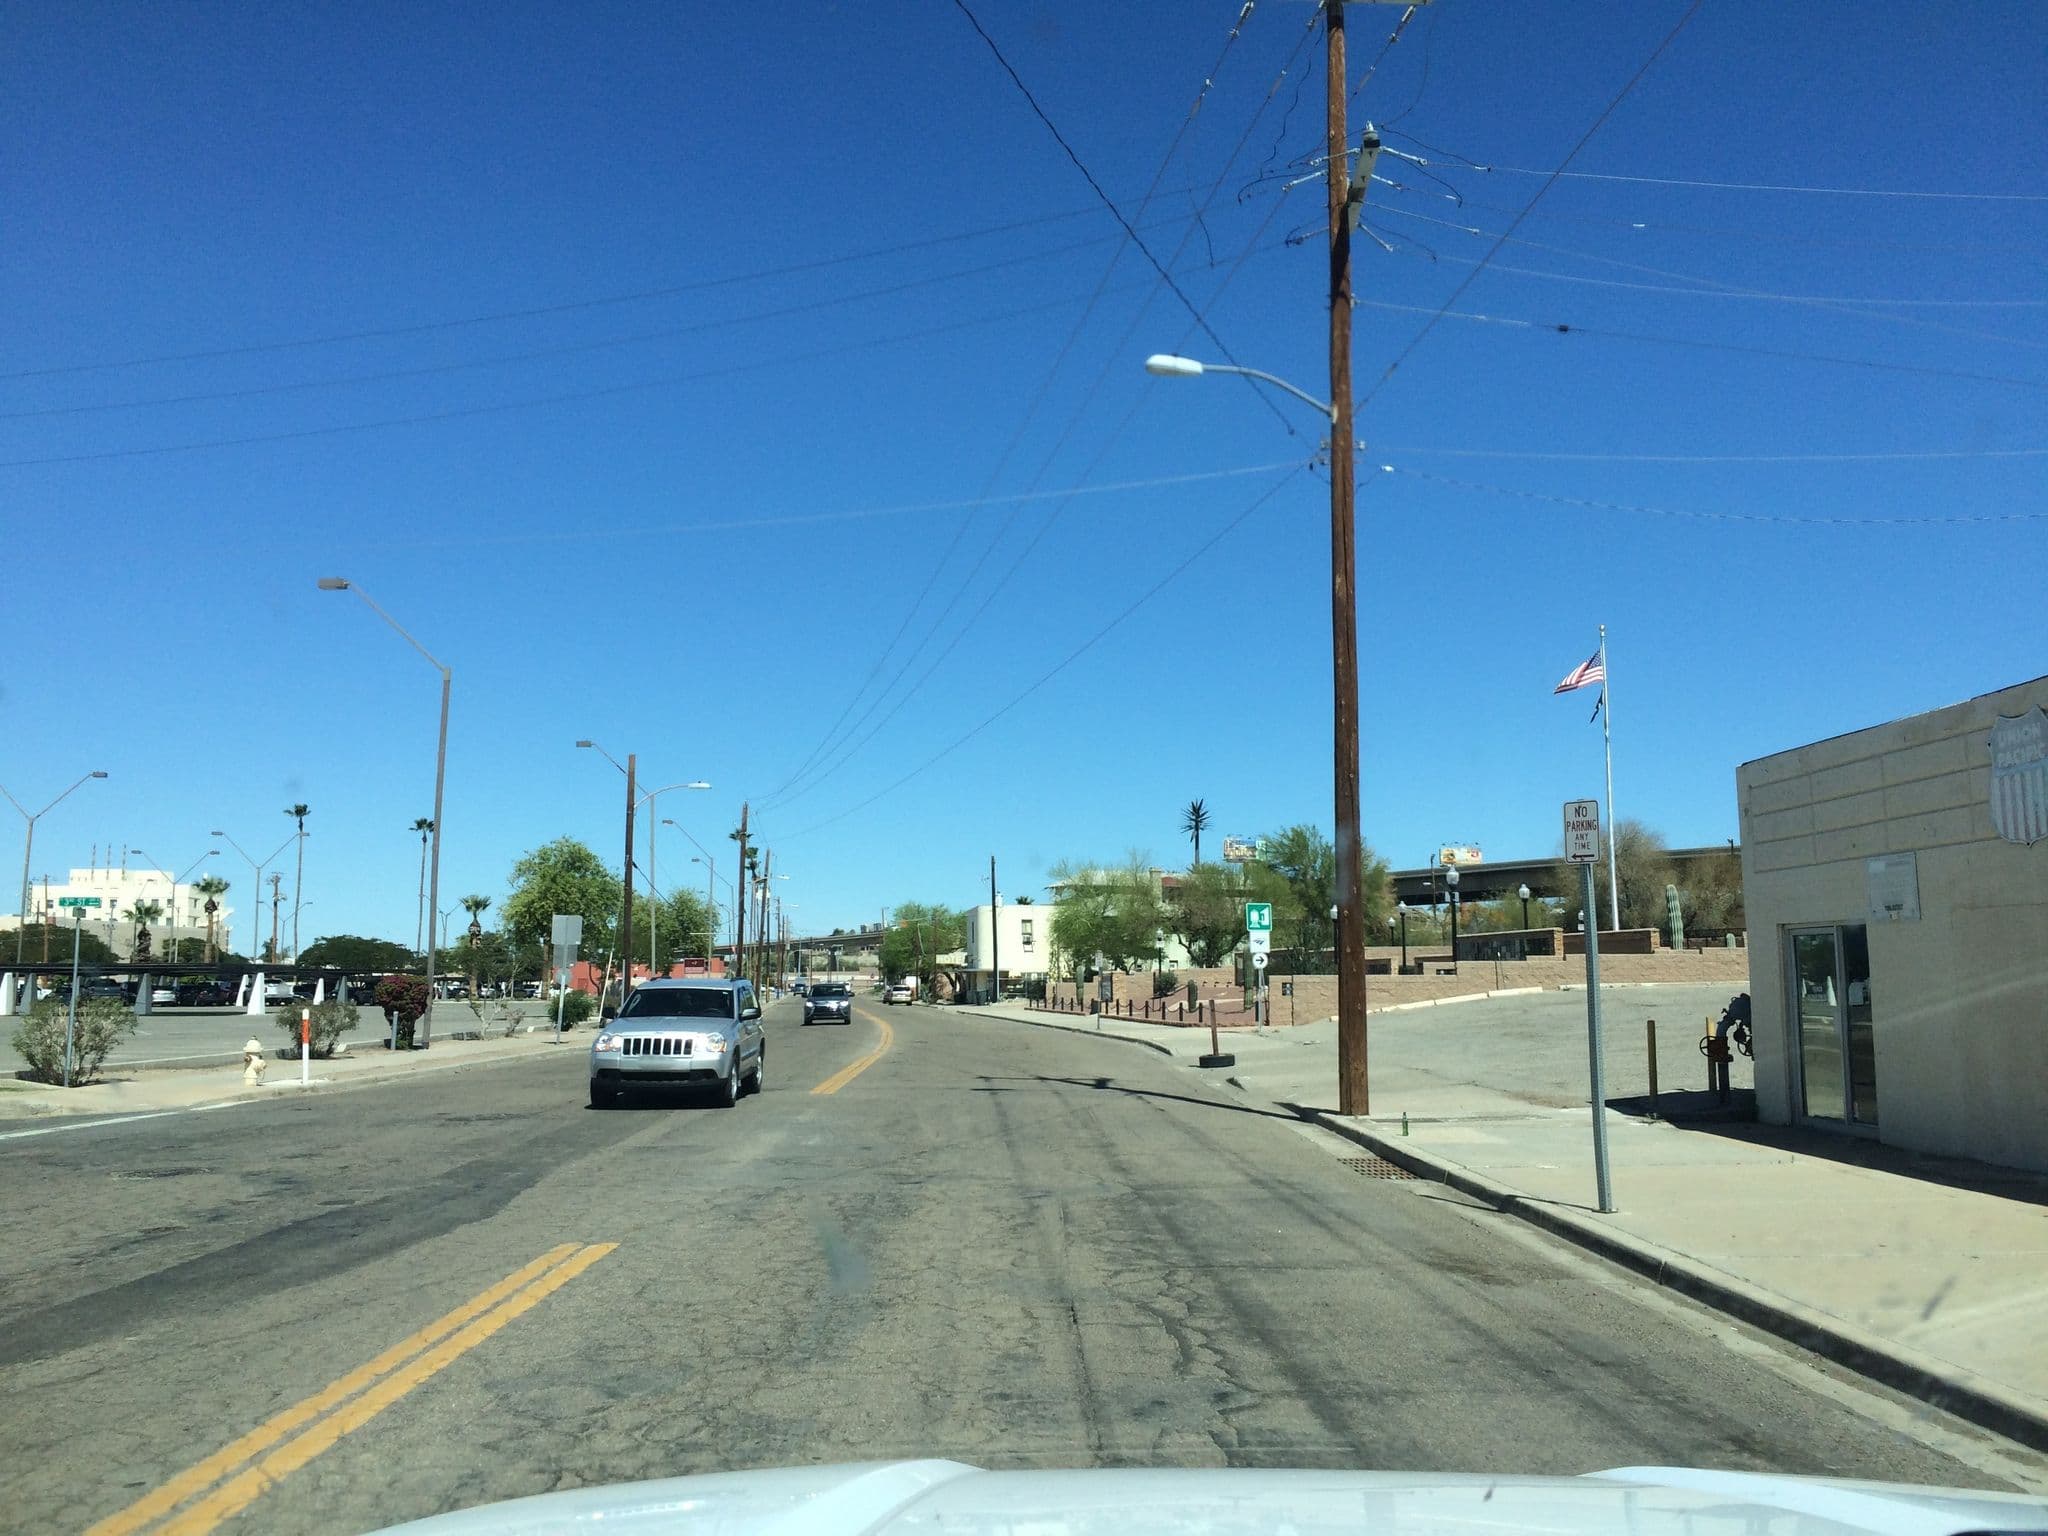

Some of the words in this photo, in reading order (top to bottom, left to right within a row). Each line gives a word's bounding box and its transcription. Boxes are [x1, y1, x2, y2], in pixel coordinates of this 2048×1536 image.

[1574, 806, 1588, 818] NO
[1566, 819, 1597, 832] PARKING
[1575, 833, 1589, 841] ANY
[1574, 841, 1591, 850] TIME
